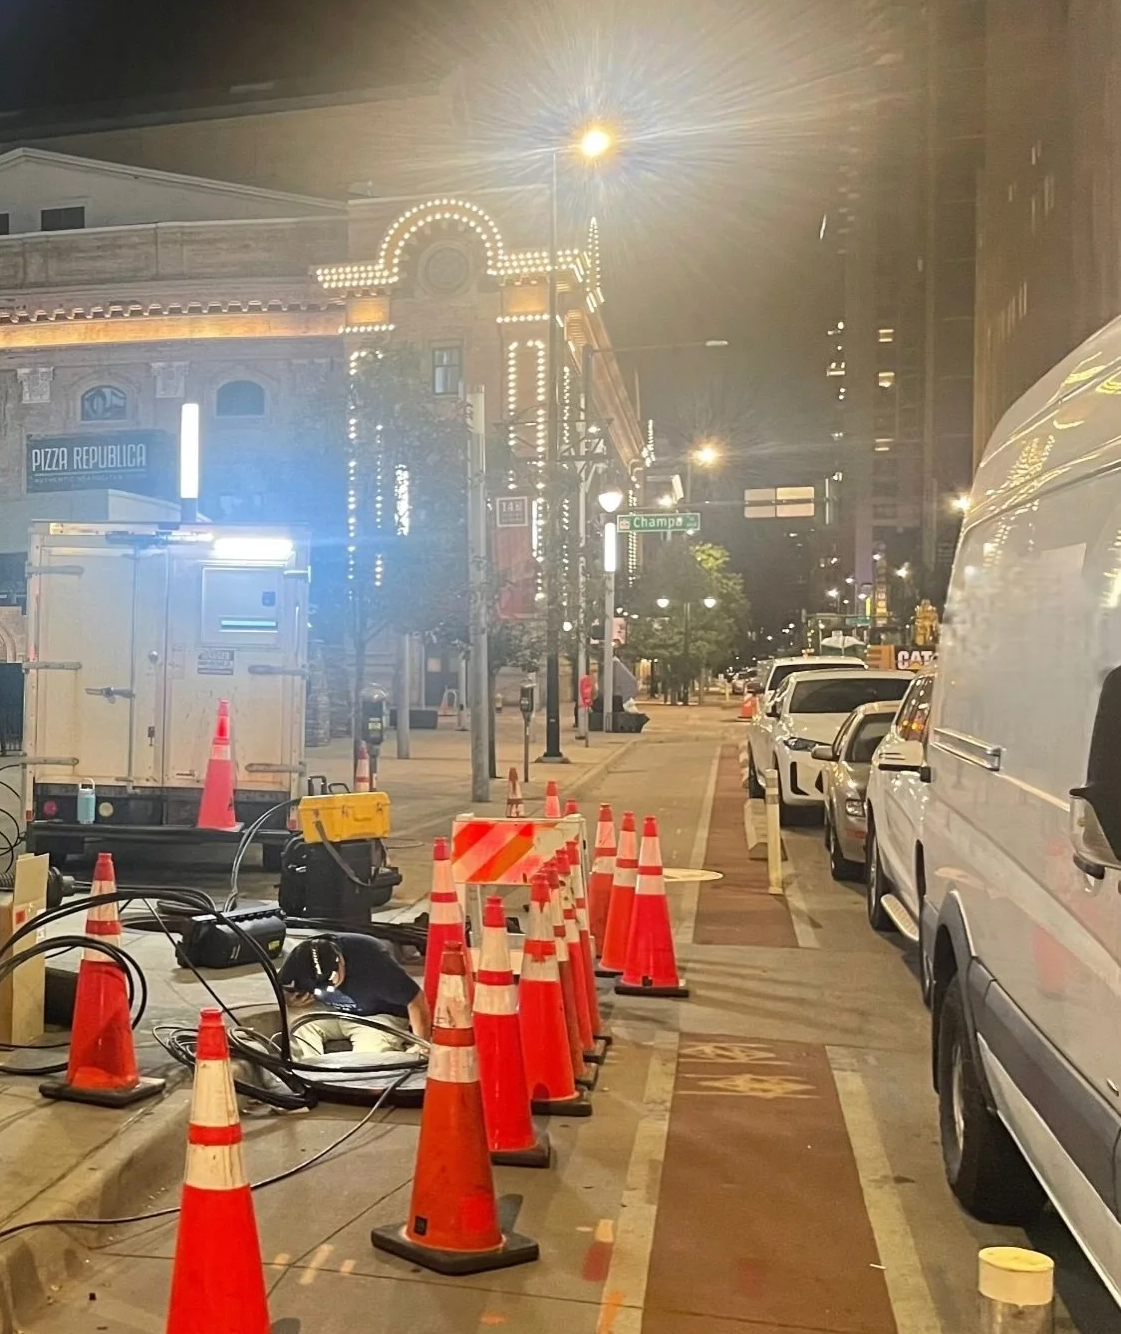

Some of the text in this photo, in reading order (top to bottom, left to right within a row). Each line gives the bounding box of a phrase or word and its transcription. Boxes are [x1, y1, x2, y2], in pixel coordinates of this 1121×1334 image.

[31, 443, 147, 471] PIZZA REPUBLICA
[633, 516, 683, 529] Champa
[897, 650, 933, 670] CAT
